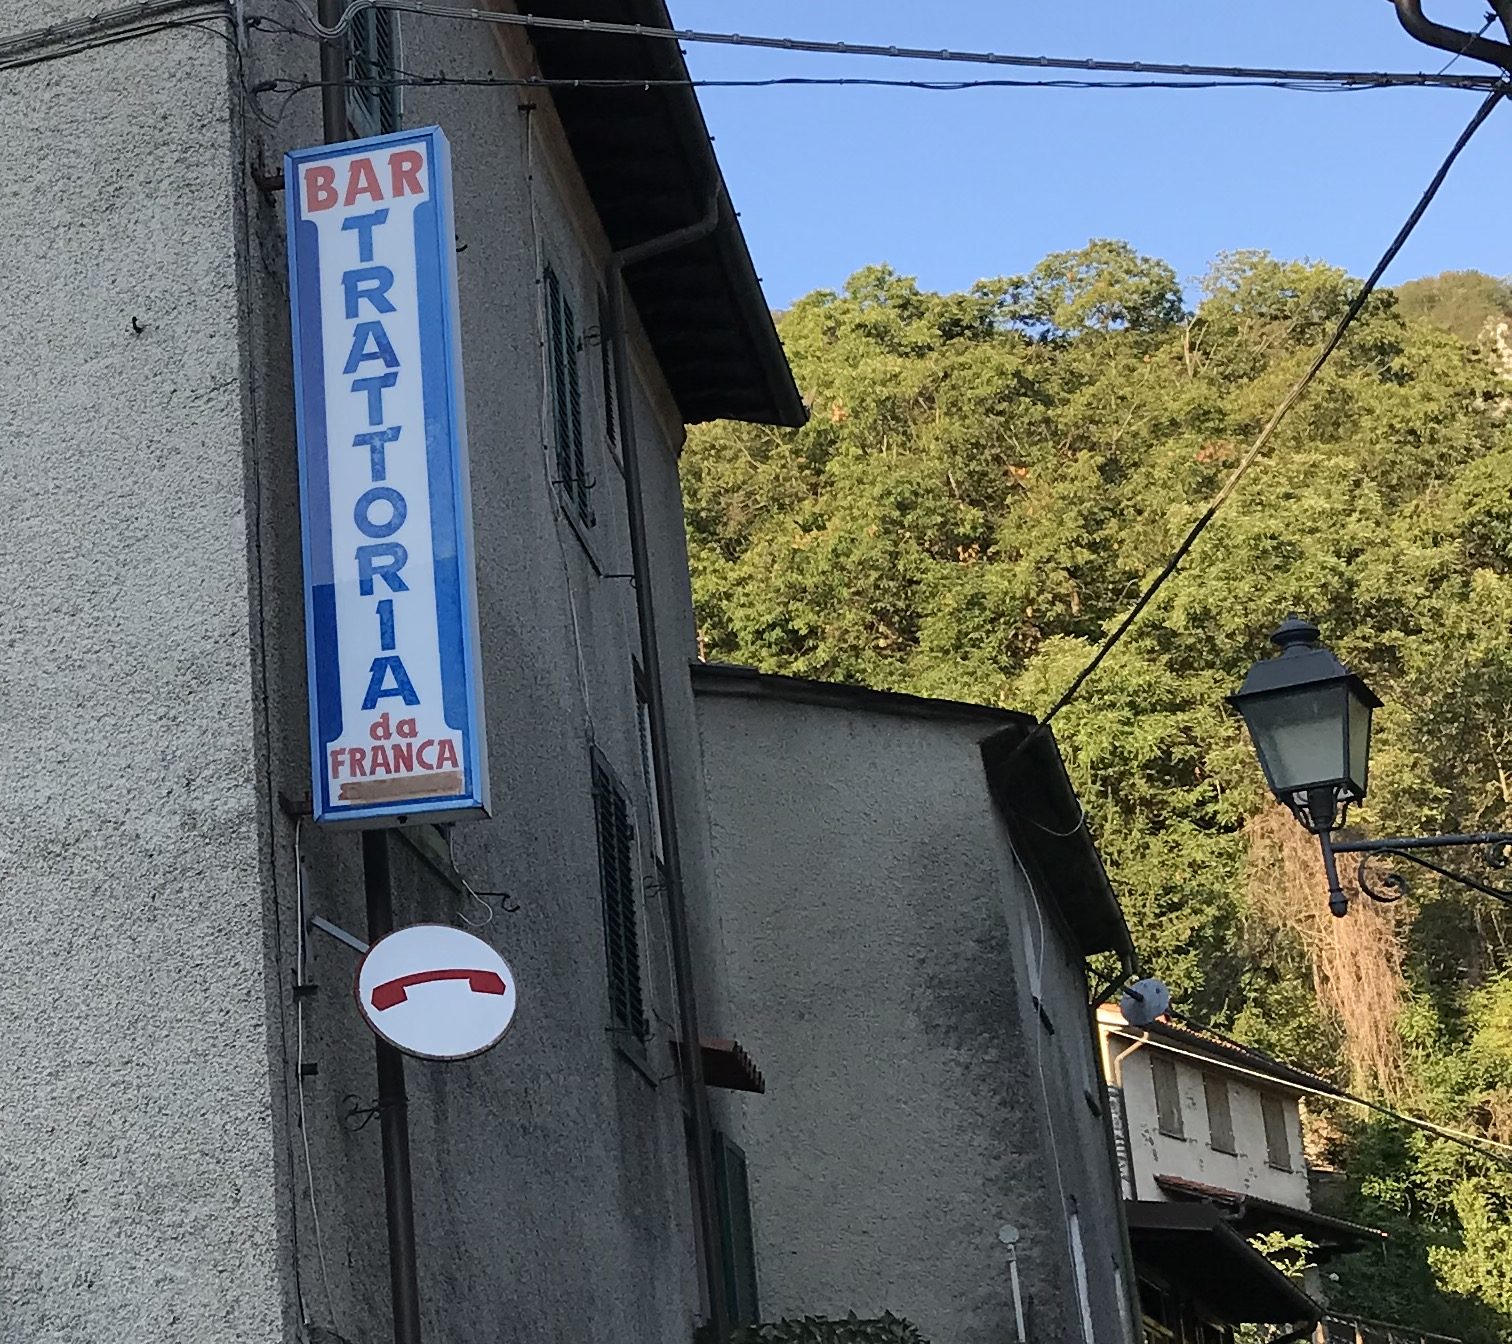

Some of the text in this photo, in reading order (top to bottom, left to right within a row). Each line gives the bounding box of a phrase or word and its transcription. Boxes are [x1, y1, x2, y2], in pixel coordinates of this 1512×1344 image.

[303, 149, 426, 214] BAR
[341, 207, 420, 712] TRATTORIA
[369, 712, 419, 741] da
[329, 738, 460, 780] FRANCA
